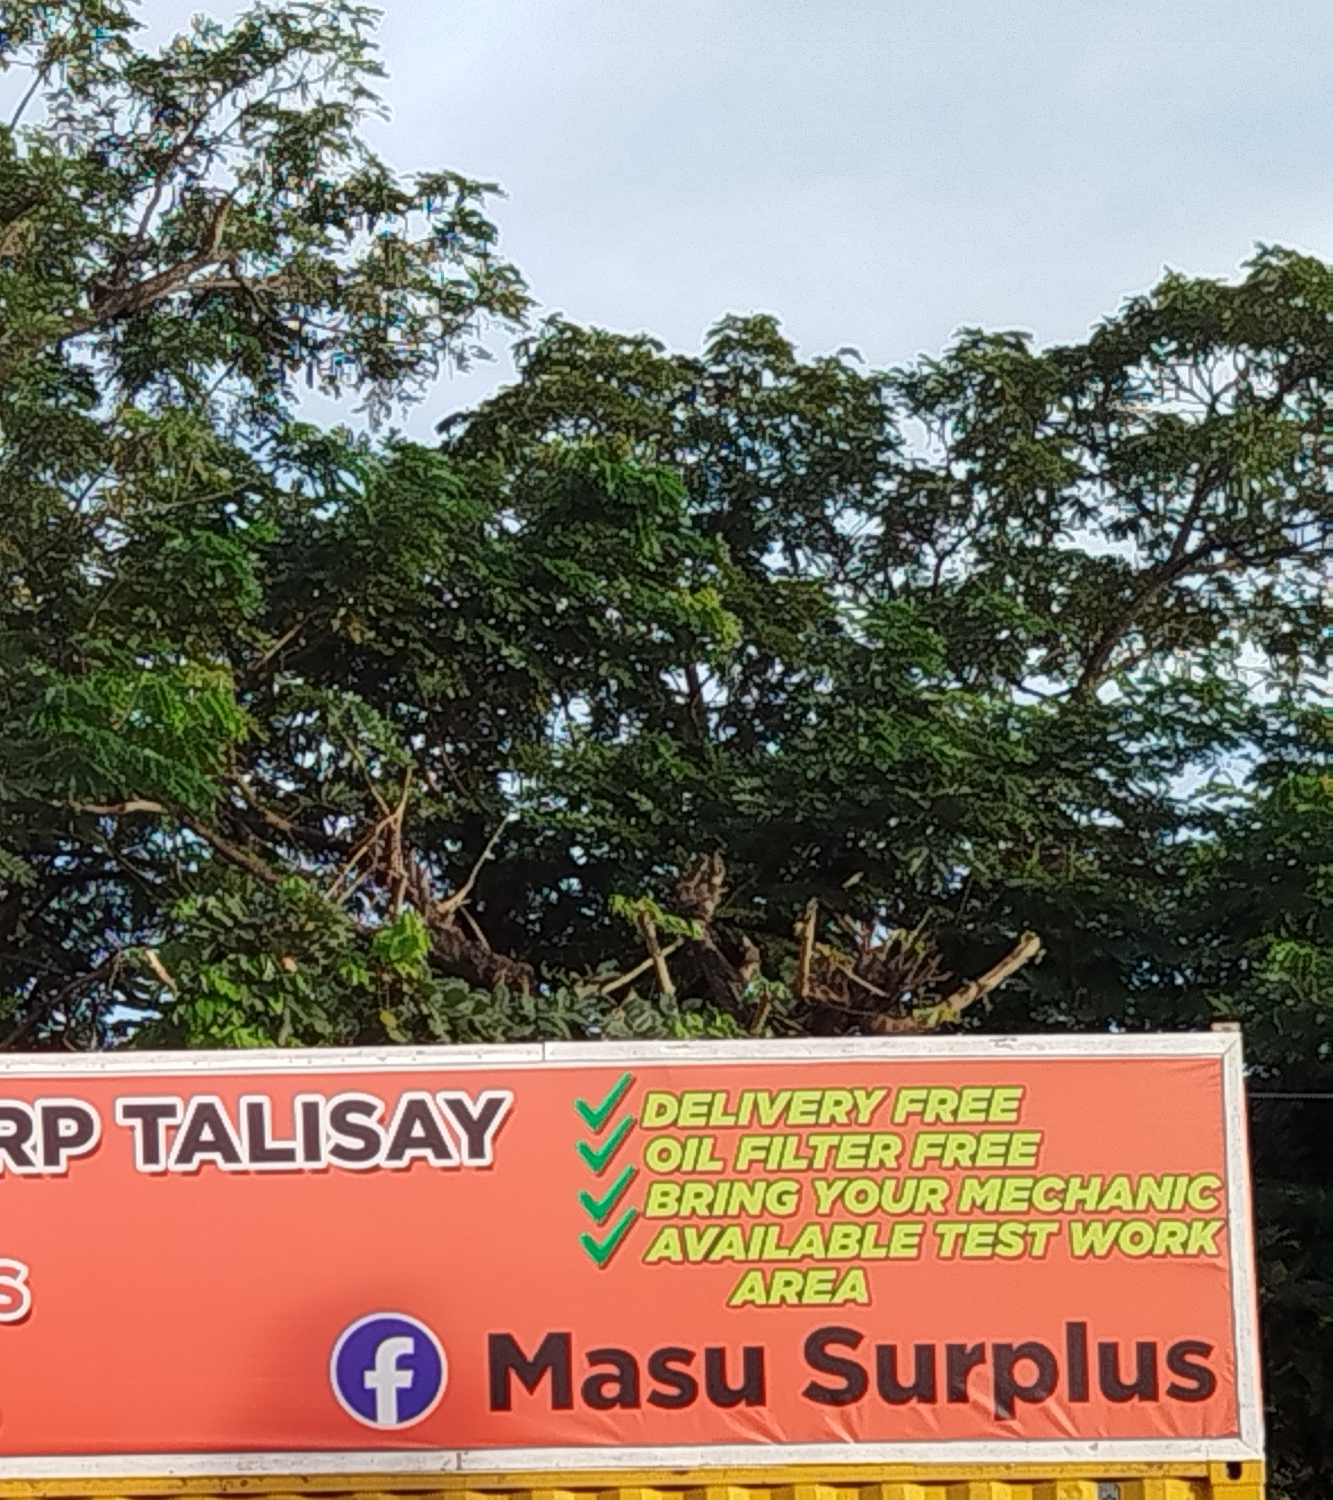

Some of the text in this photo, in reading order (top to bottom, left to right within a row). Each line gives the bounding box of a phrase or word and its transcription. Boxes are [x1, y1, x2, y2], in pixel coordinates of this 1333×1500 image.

[641, 1085, 1025, 1129] DELIVERY FREE
[115, 1090, 513, 1174] TALISAY
[644, 1131, 1042, 1174] OIL FILTER FREE
[644, 1172, 1223, 1220] BRING YOUR MECHANIC
[642, 1218, 1225, 1265] AVAILABLE TEST WORK
[727, 1268, 870, 1309] AREA
[487, 1321, 1218, 1421] Masu Surplus
